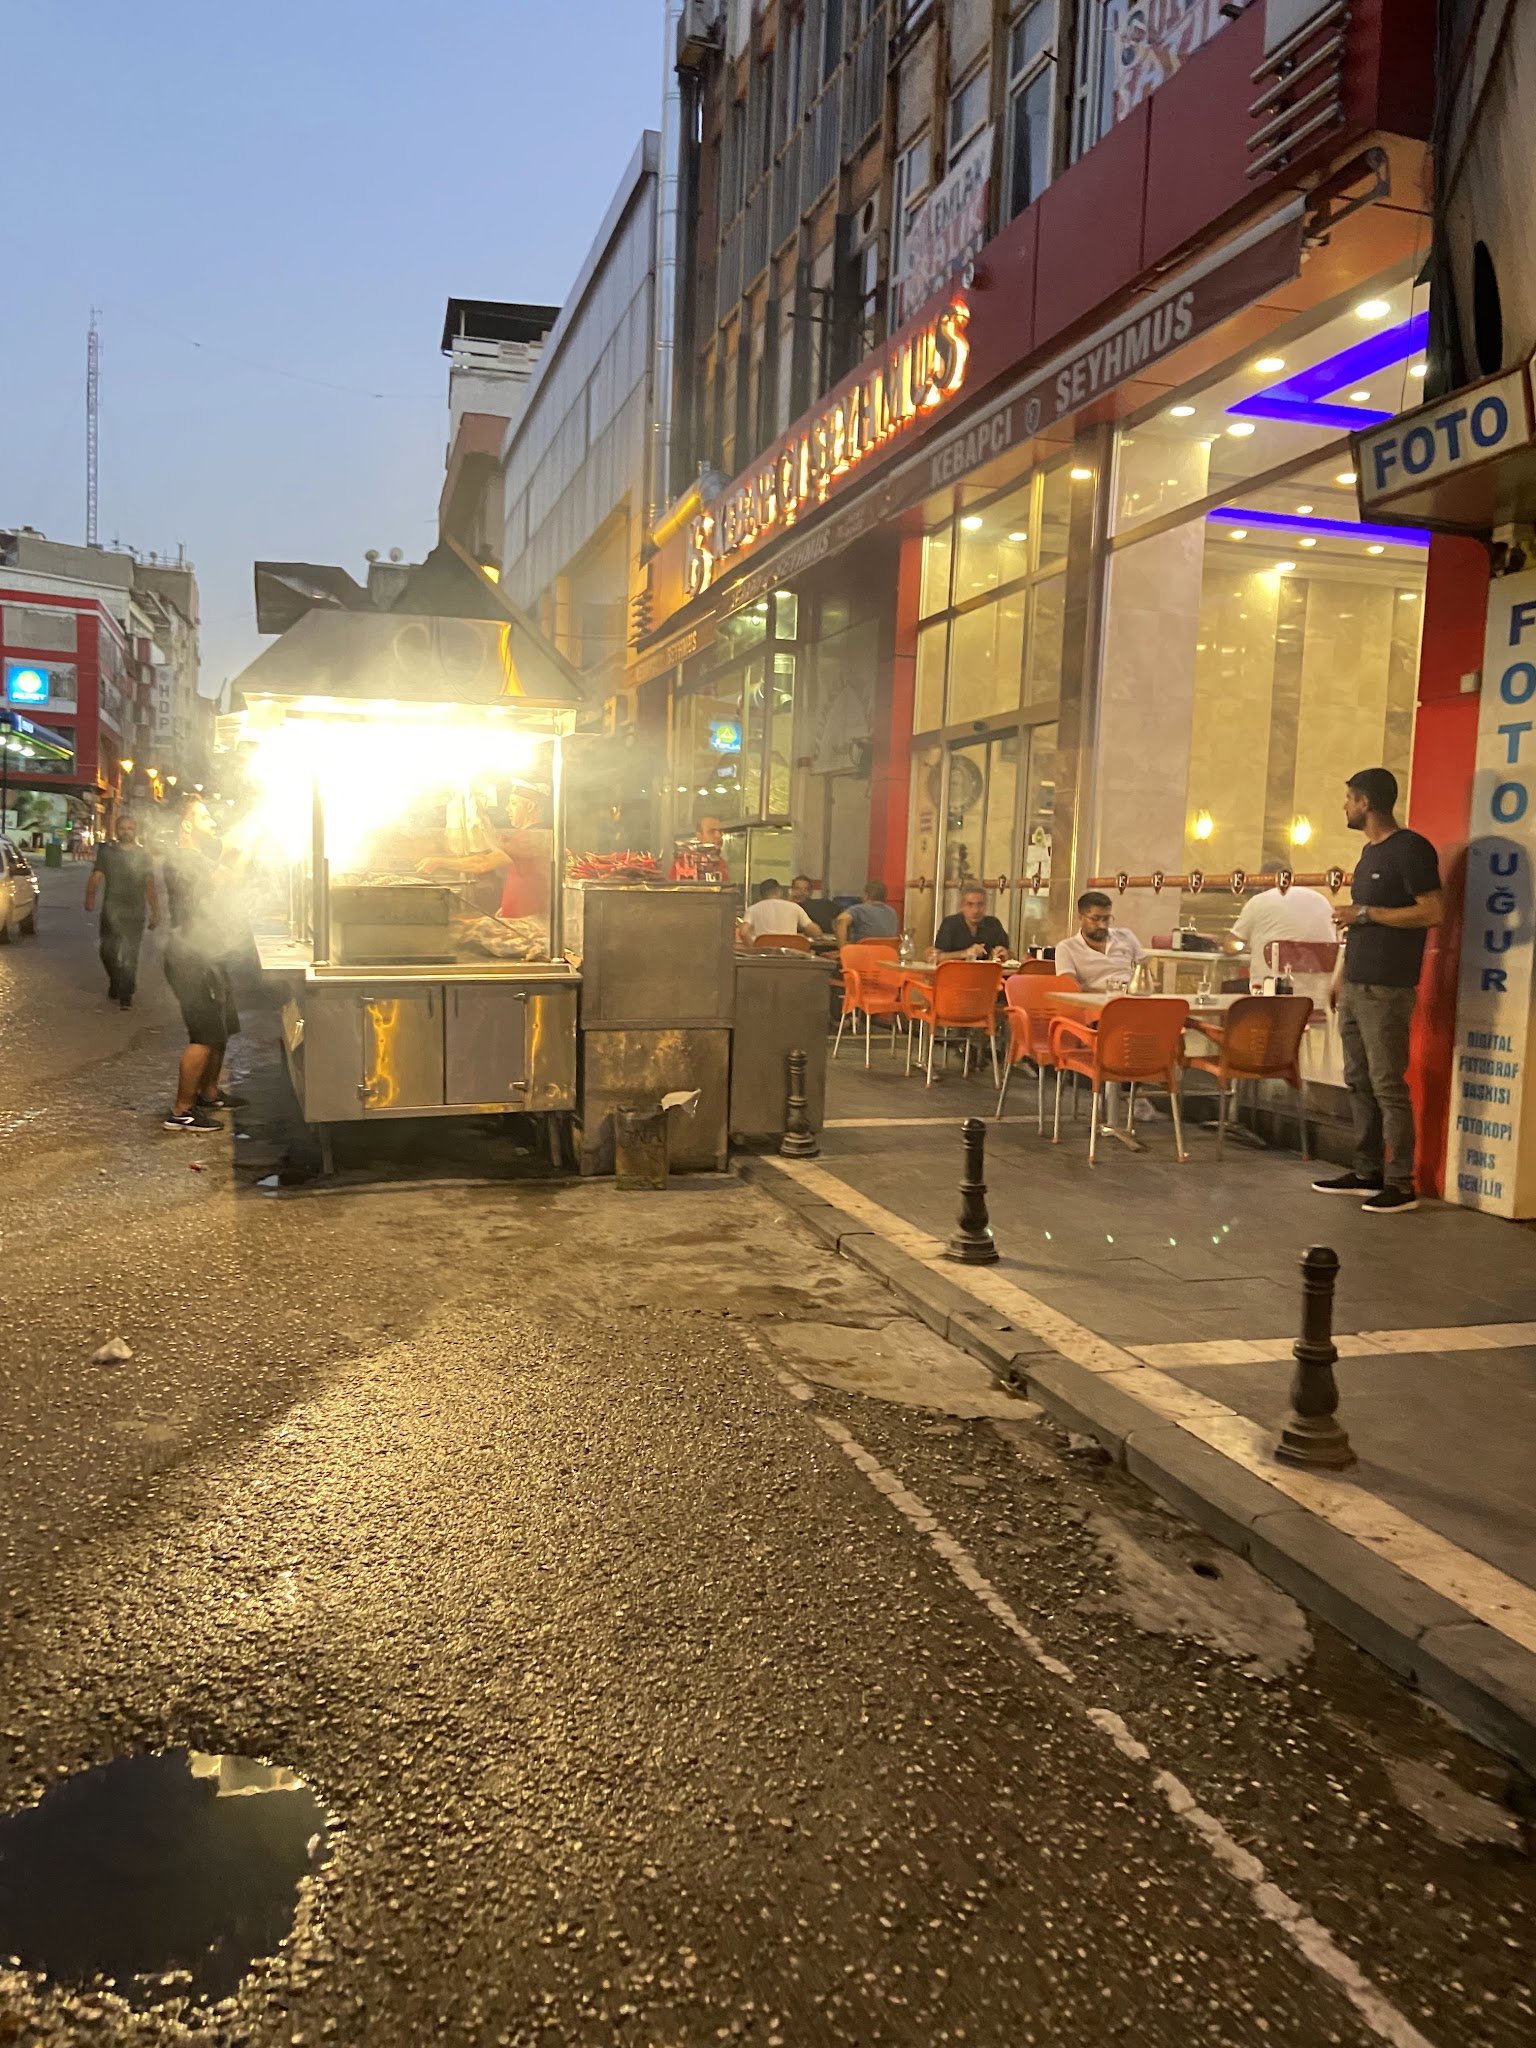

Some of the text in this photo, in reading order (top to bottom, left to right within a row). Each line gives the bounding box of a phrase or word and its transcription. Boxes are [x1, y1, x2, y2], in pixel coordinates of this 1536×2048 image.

[1373, 396, 1508, 490] FOTO
[1480, 600, 1536, 992] FOTO UĞUR
